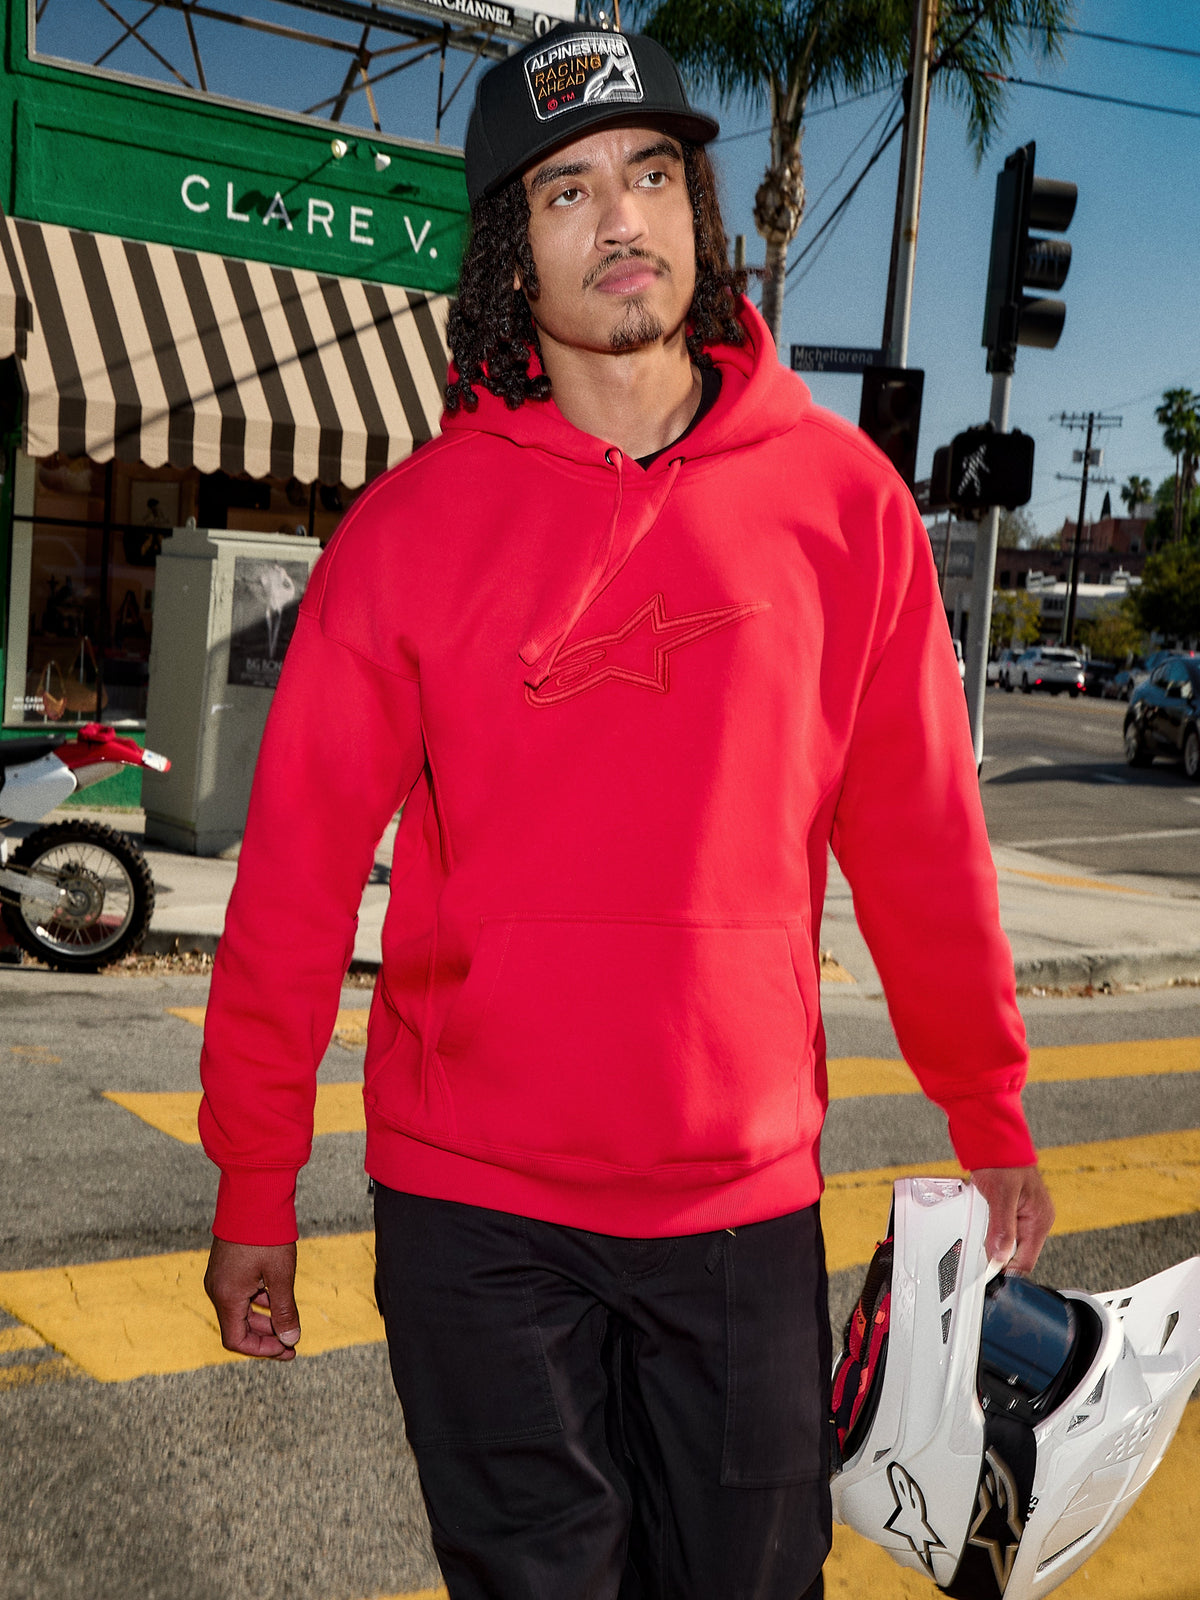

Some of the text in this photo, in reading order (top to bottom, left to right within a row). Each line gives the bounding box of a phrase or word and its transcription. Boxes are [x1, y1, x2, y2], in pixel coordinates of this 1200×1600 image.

[535, 52, 602, 88] RACING
[537, 71, 586, 100] AHEAD
[181, 174, 438, 259] CLARE V.
[794, 346, 874, 364] Micheltorena
